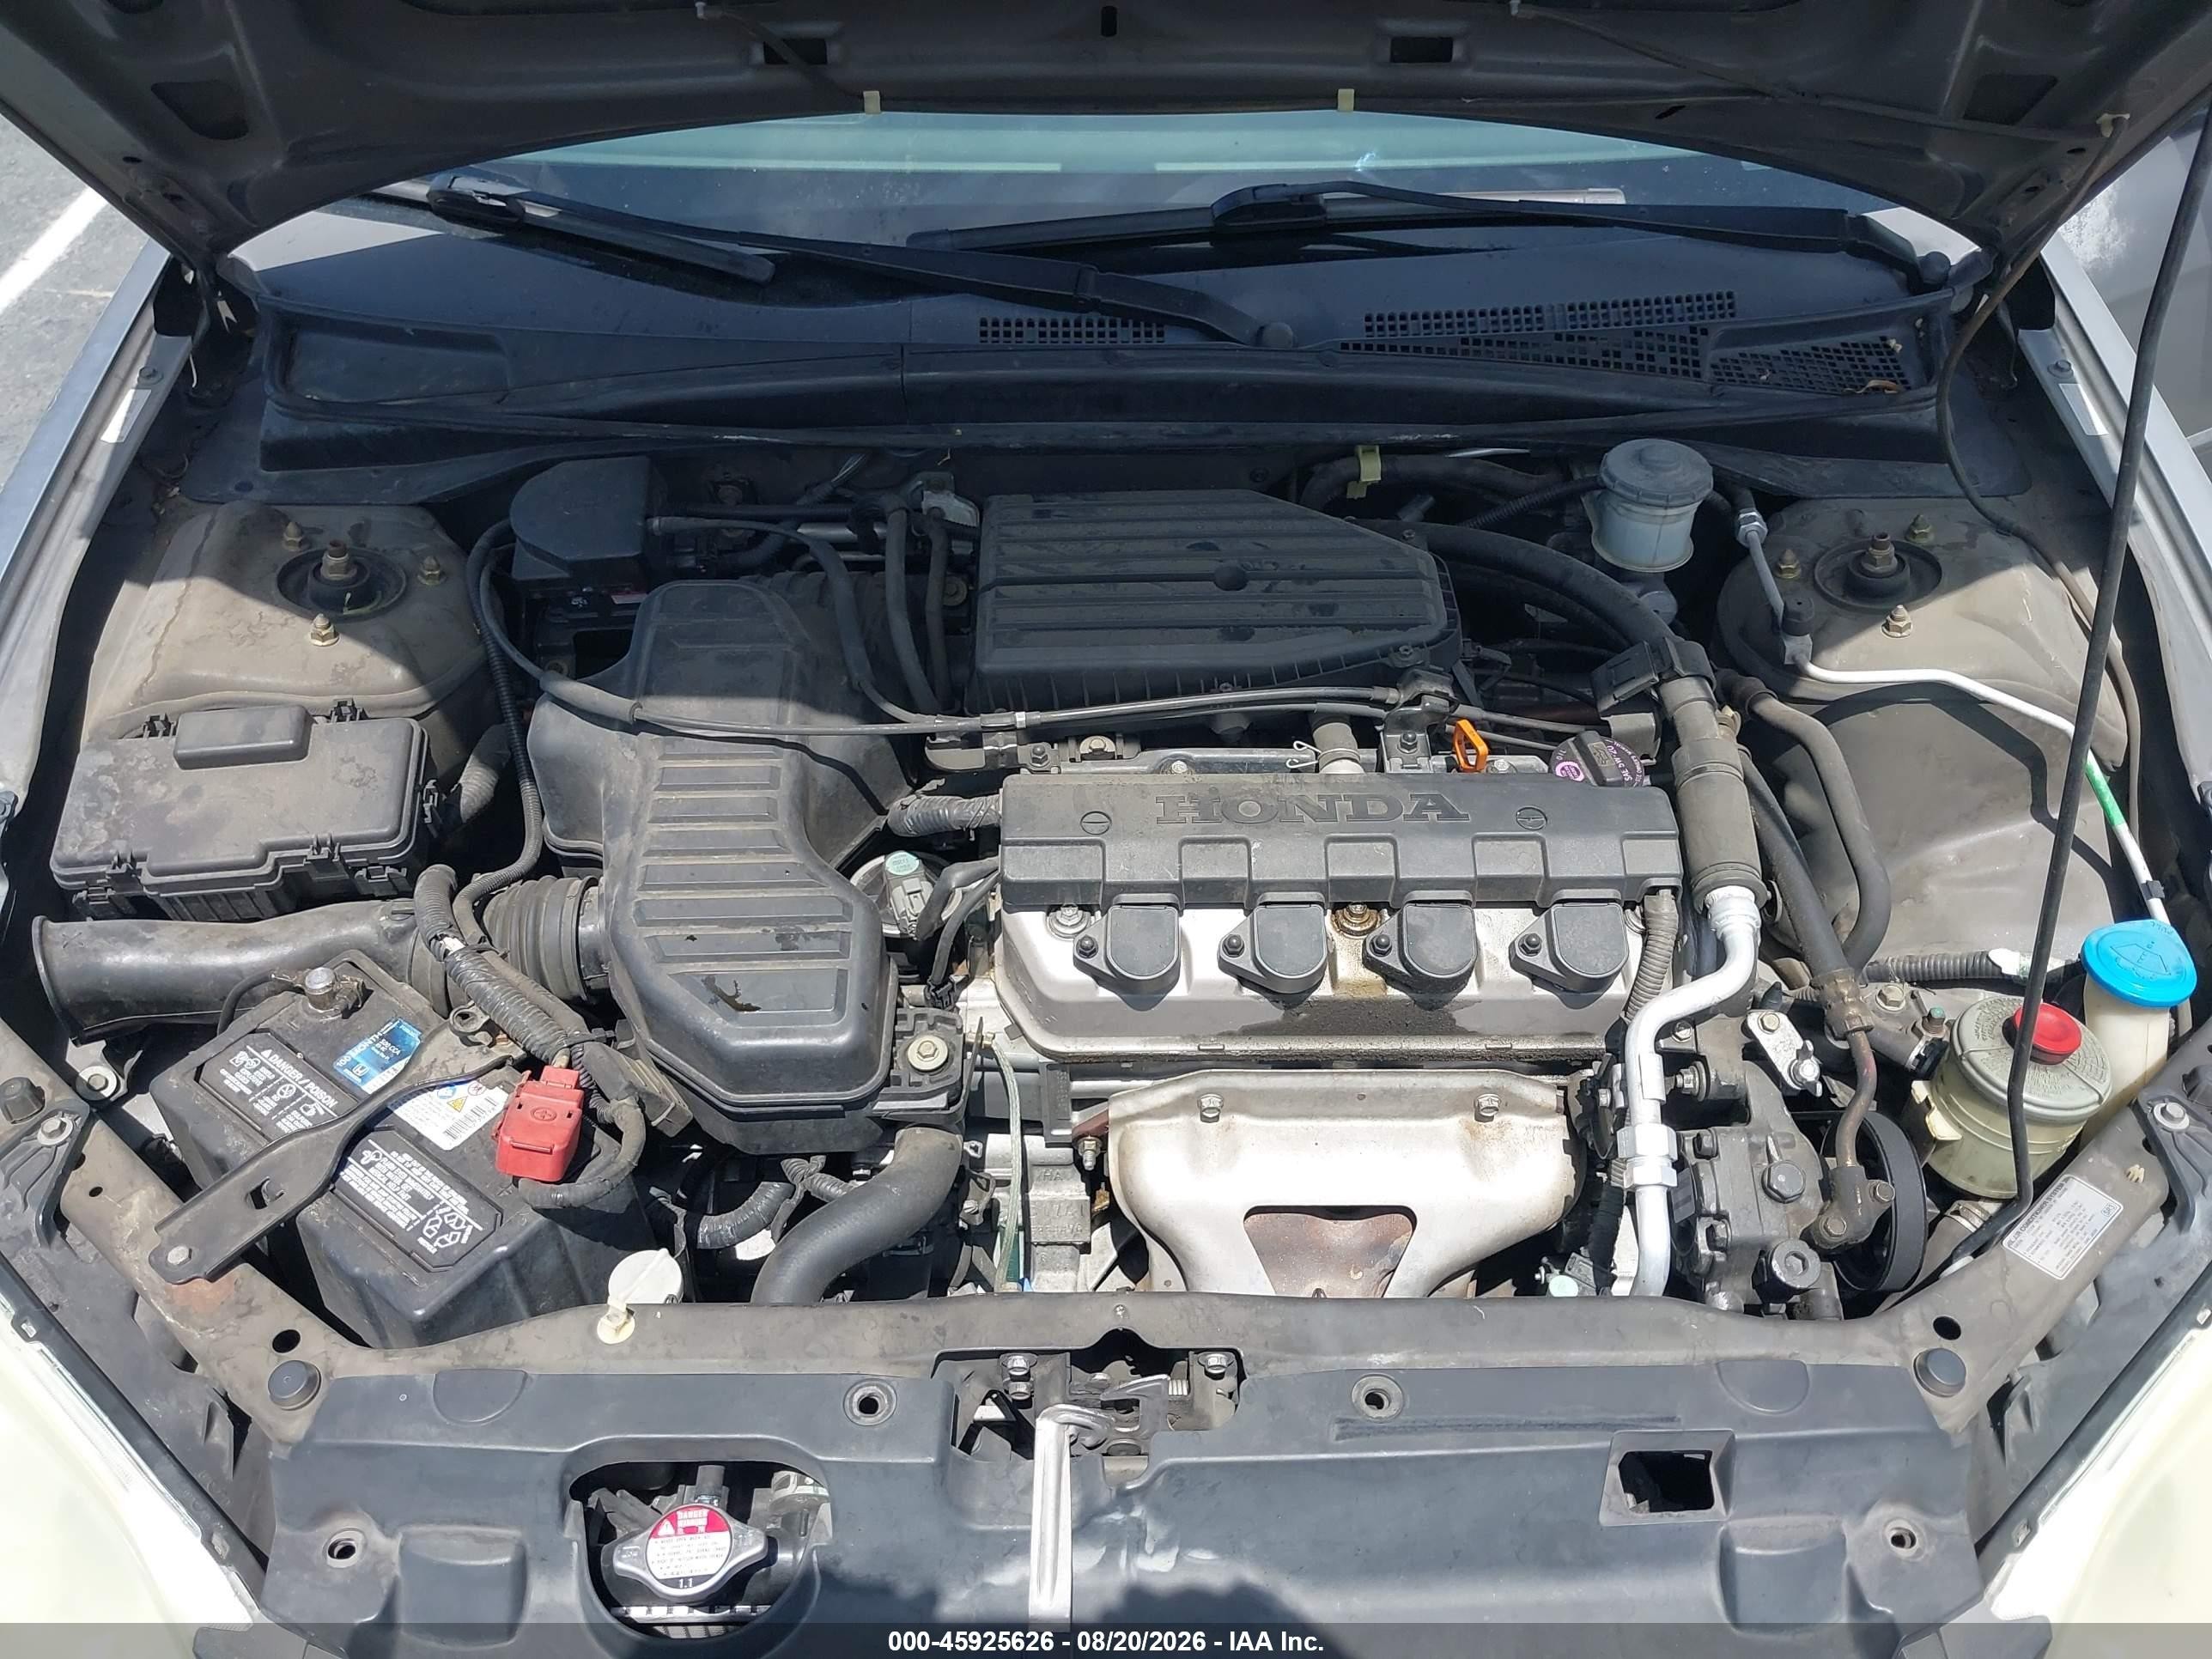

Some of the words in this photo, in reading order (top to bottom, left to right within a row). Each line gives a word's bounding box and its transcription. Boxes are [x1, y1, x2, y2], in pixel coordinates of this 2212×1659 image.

[1620, 768, 1632, 781] SAE
[1156, 793, 1470, 824] HONDA
[334, 1054, 352, 1067] 100
[349, 1031, 382, 1057] MONTH
[387, 1044, 401, 1055] CCA
[267, 1054, 303, 1081] DANGER
[304, 1082, 337, 1109] POISON
[386, 1181, 400, 1192] HELP
[677, 1510, 708, 1519] DANGER
[678, 1578, 693, 1589] 1.1
